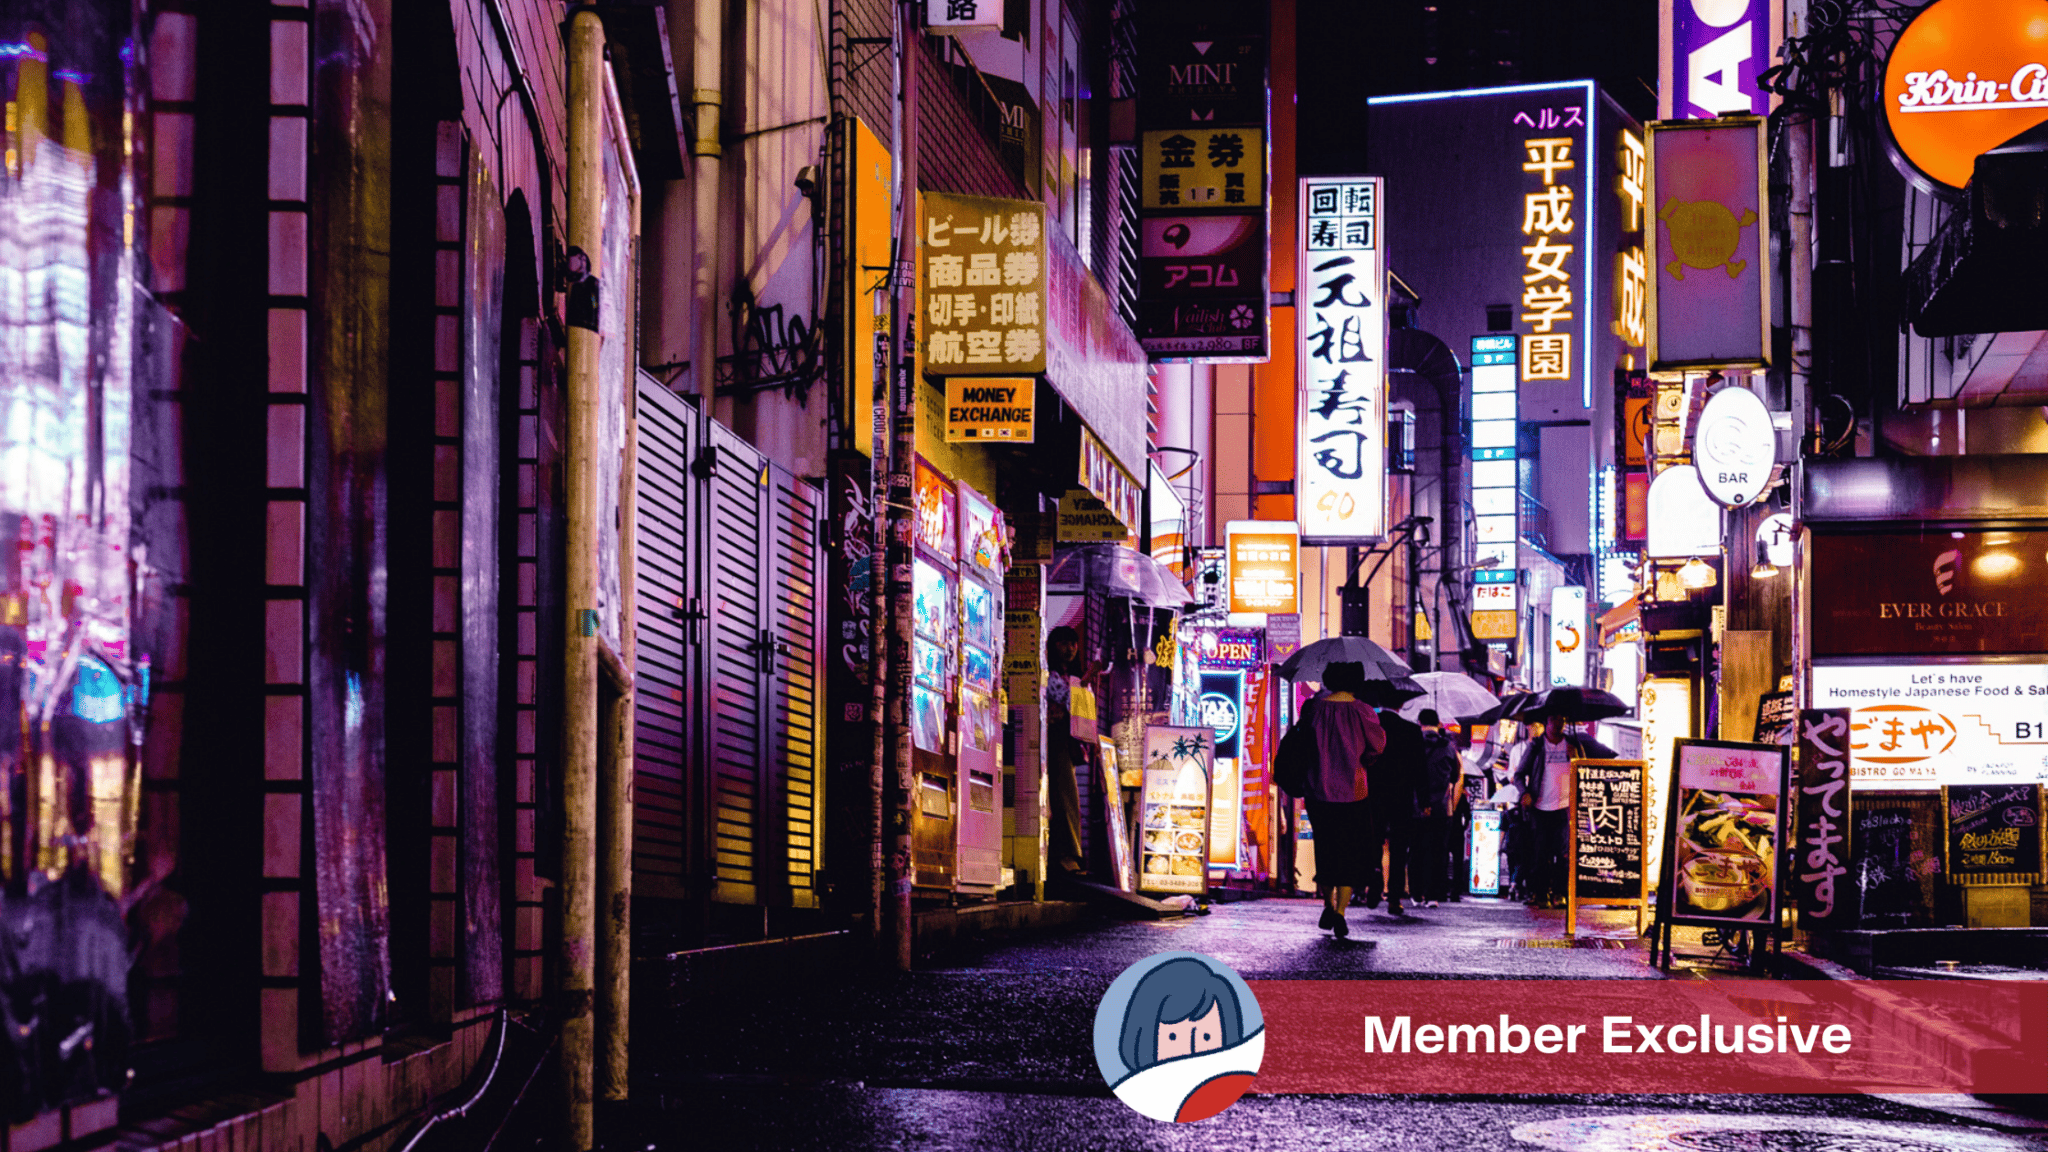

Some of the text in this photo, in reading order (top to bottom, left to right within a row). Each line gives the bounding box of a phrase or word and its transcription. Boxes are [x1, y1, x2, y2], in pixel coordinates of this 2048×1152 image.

[1168, 62, 1238, 86] MINT
[1513, 105, 1585, 130] ヘルス
[1312, 186, 1371, 215] 回転
[927, 211, 1041, 248] ビール券
[1312, 219, 1371, 247] 寿司
[927, 251, 1040, 289] 商品券
[1521, 136, 1575, 381] 平成女学園
[1163, 263, 1240, 290] アコム
[927, 328, 1042, 364] 航空券
[1307, 255, 1373, 479] 元祖寿司
[962, 387, 1017, 403] MONEY
[949, 407, 1032, 423] EXCHANGE
[1717, 471, 1749, 484] BAR
[1879, 602, 1933, 618] EVER
[1938, 601, 2008, 618] GRACE
[1207, 643, 1252, 660] OPEN
[1949, 673, 1983, 684] have
[1828, 687, 1902, 701] Homestyle
[1904, 686, 1971, 700] Japanese
[1974, 685, 2010, 697] Food
[2014, 684, 2024, 696] &
[1201, 700, 1232, 715] TAX
[1850, 716, 1946, 753] ごまや
[2015, 721, 2043, 739] B1
[1850, 767, 1887, 776] BISTRO
[1893, 767, 1906, 776] GO
[1609, 781, 1641, 793] WINE
[1587, 794, 1624, 835] 肉
[1801, 711, 1848, 918] やってます
